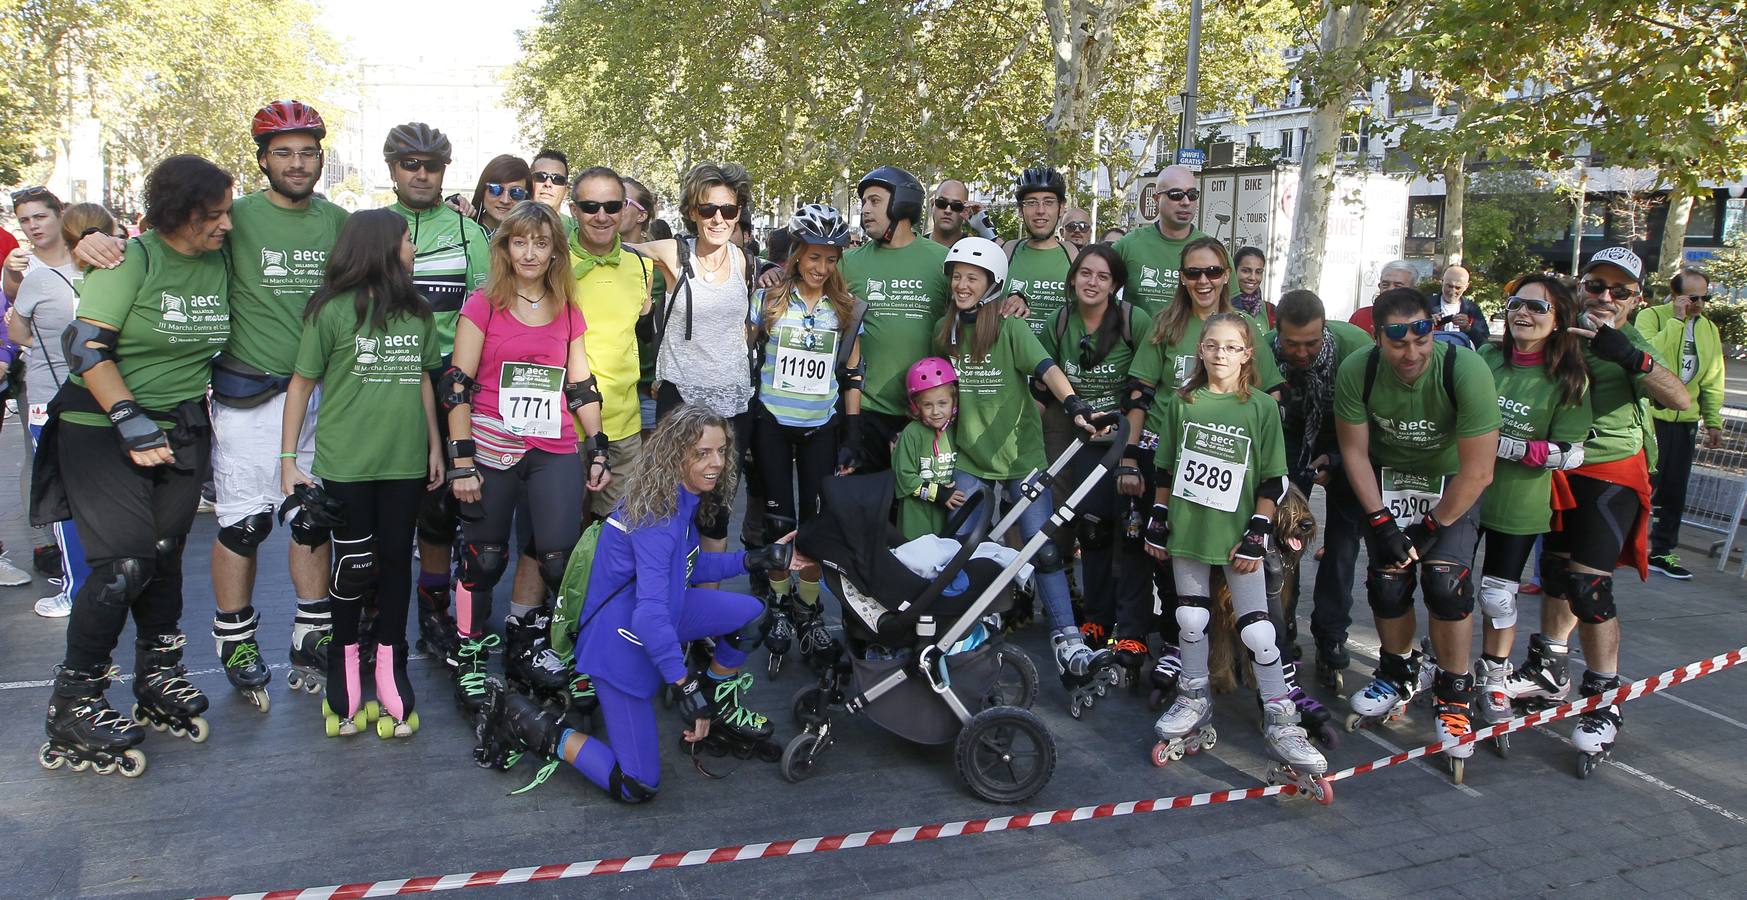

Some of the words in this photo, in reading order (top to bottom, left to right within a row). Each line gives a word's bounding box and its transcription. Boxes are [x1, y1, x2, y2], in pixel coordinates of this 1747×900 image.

[1211, 180, 1227, 192] CITY
[1244, 178, 1262, 191] BIKE
[1246, 213, 1267, 223] TOURS
[293, 249, 326, 262] aecc
[1163, 268, 1180, 279] ae
[890, 279, 923, 289] aecc
[1033, 280, 1065, 290] aecc
[190, 295, 220, 307] aecc
[168, 323, 193, 331] Marcha
[384, 335, 419, 347] aecc
[526, 367, 550, 376] aecc
[780, 355, 826, 380] 11190
[509, 396, 551, 420] 7771
[1497, 395, 1532, 416] aecc
[1398, 419, 1437, 431] aecc
[1210, 434, 1234, 446] aecc
[1183, 459, 1233, 492] 5289
[1390, 496, 1430, 519] 5290
